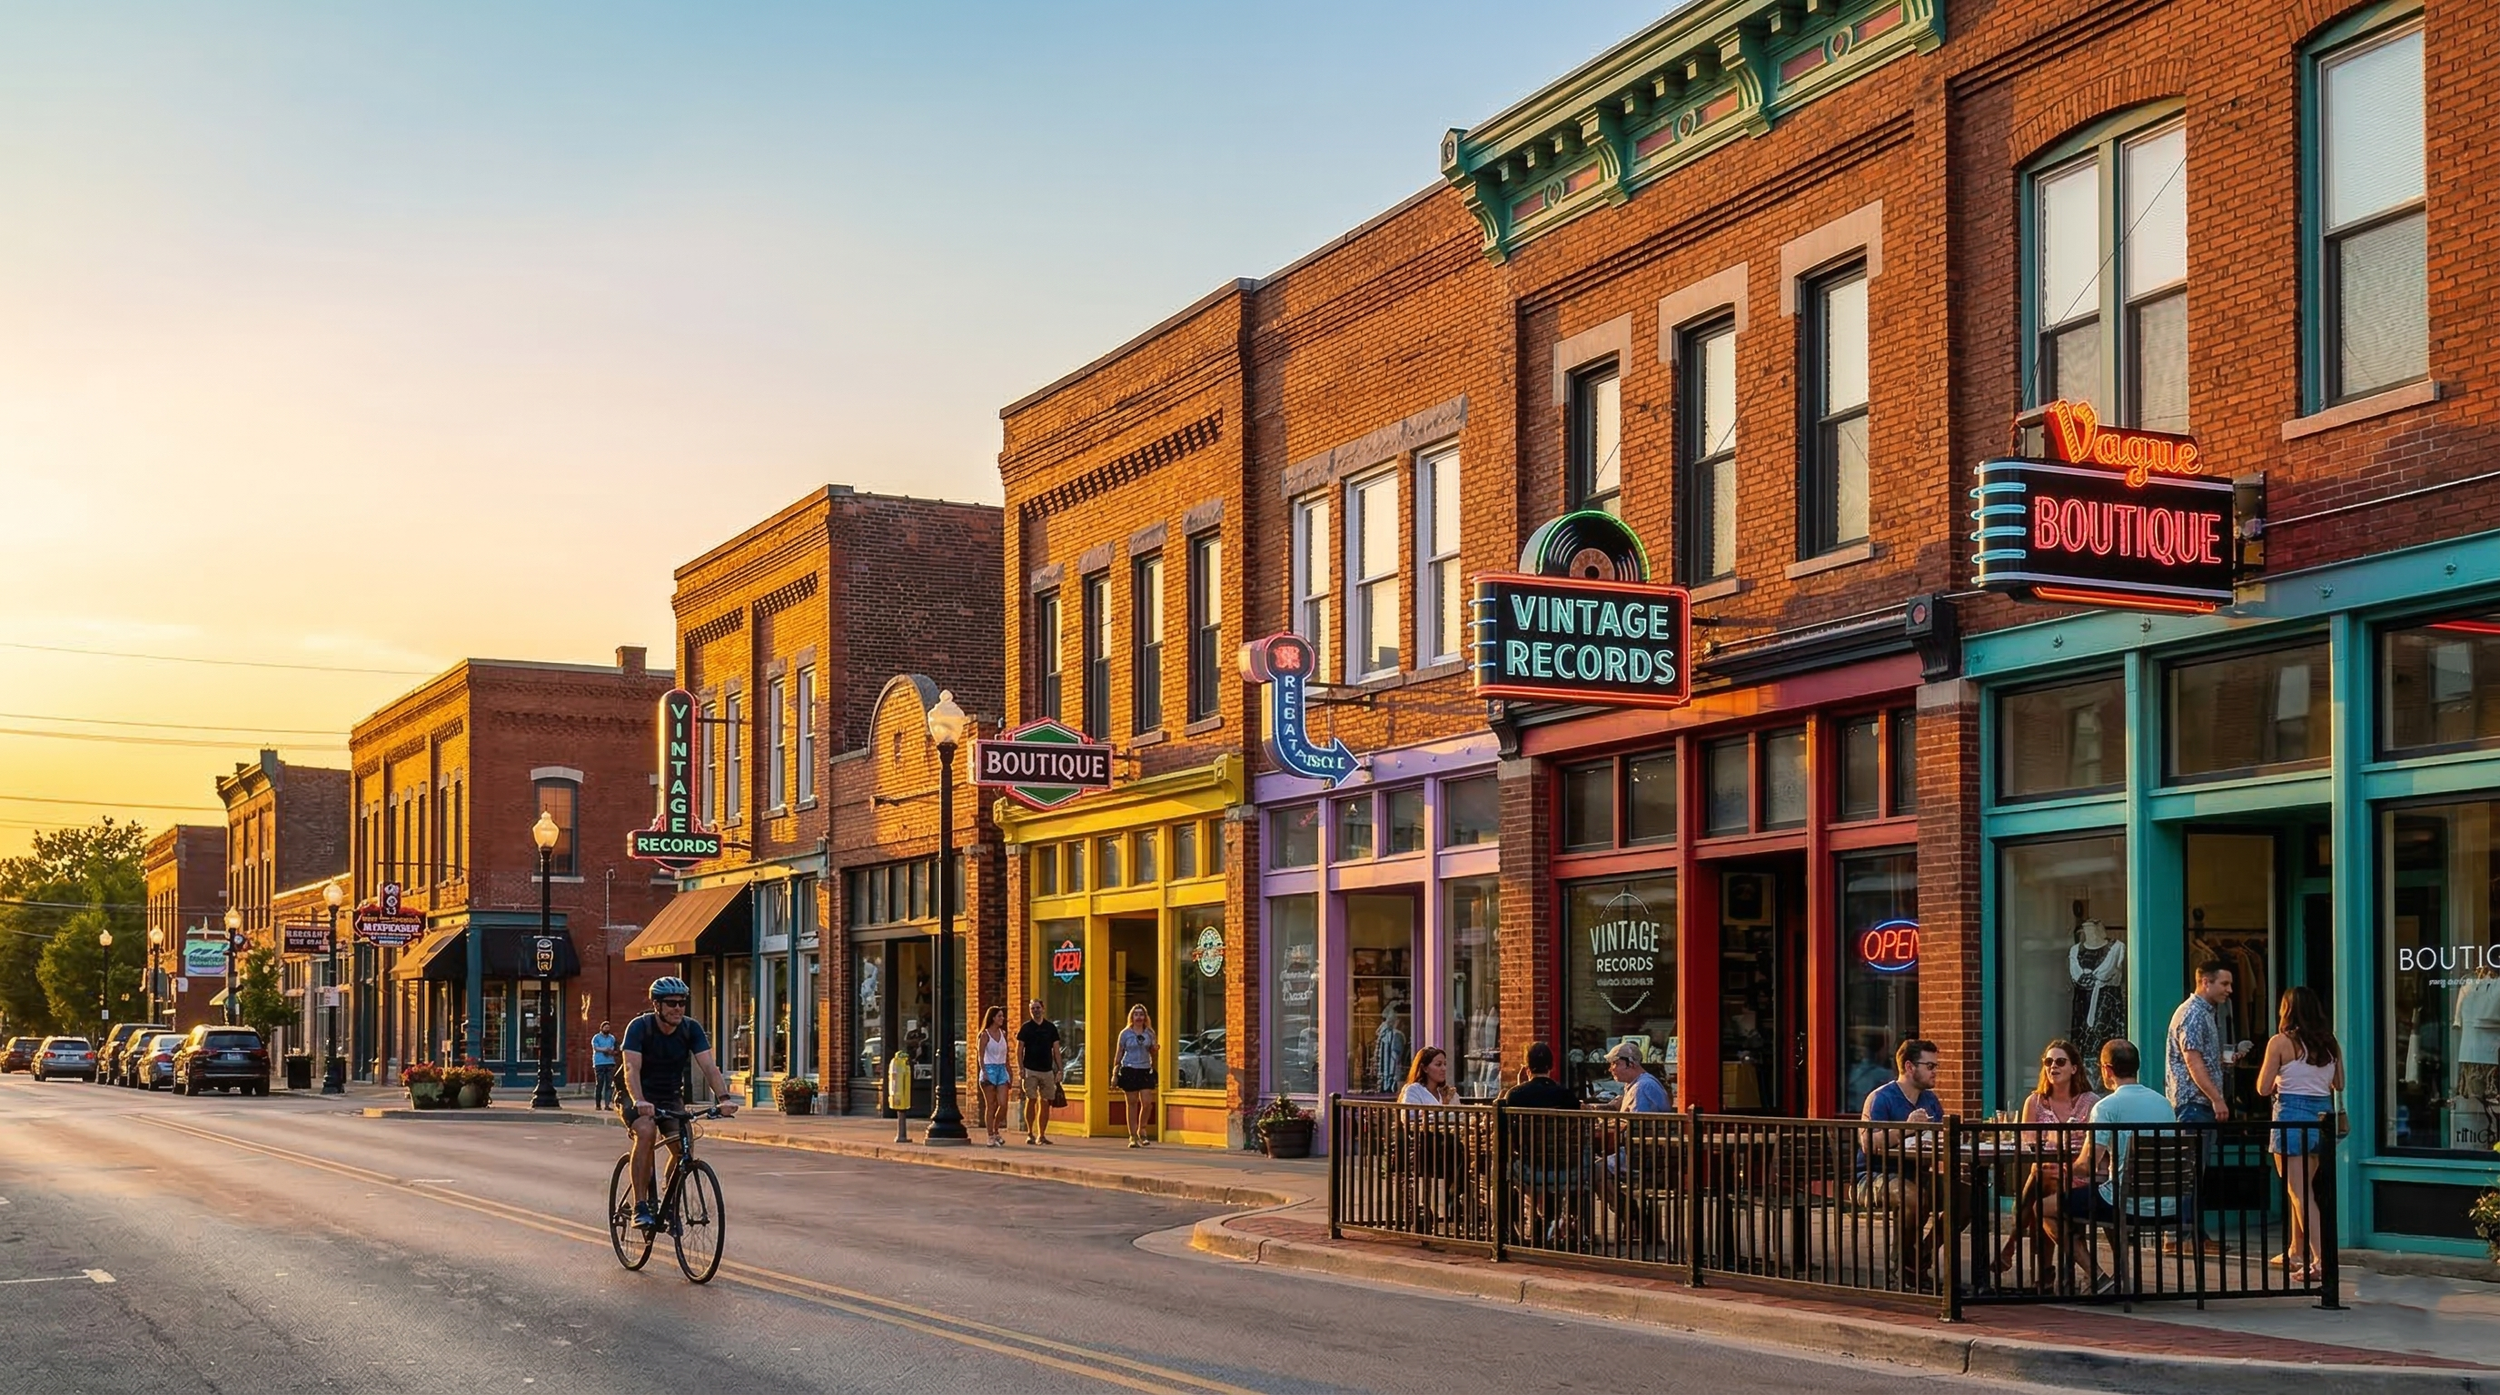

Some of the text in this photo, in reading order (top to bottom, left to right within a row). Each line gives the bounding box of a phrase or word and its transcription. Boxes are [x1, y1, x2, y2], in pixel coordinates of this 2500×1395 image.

[2054, 399, 2202, 487] Vague
[2034, 496, 2221, 565] BOUTIQUE
[1510, 594, 1669, 640] VINTAGE
[1506, 640, 1675, 685] RECORDS
[669, 702, 690, 834] VINTAGE
[986, 750, 1106, 781] BOUTIQUE
[637, 836, 719, 855] RECORDS
[1589, 919, 1661, 956] VINTAGE
[1864, 929, 1919, 960] OPEN
[1053, 951, 1082, 973] OPEN
[1596, 956, 1654, 973] RECORDS
